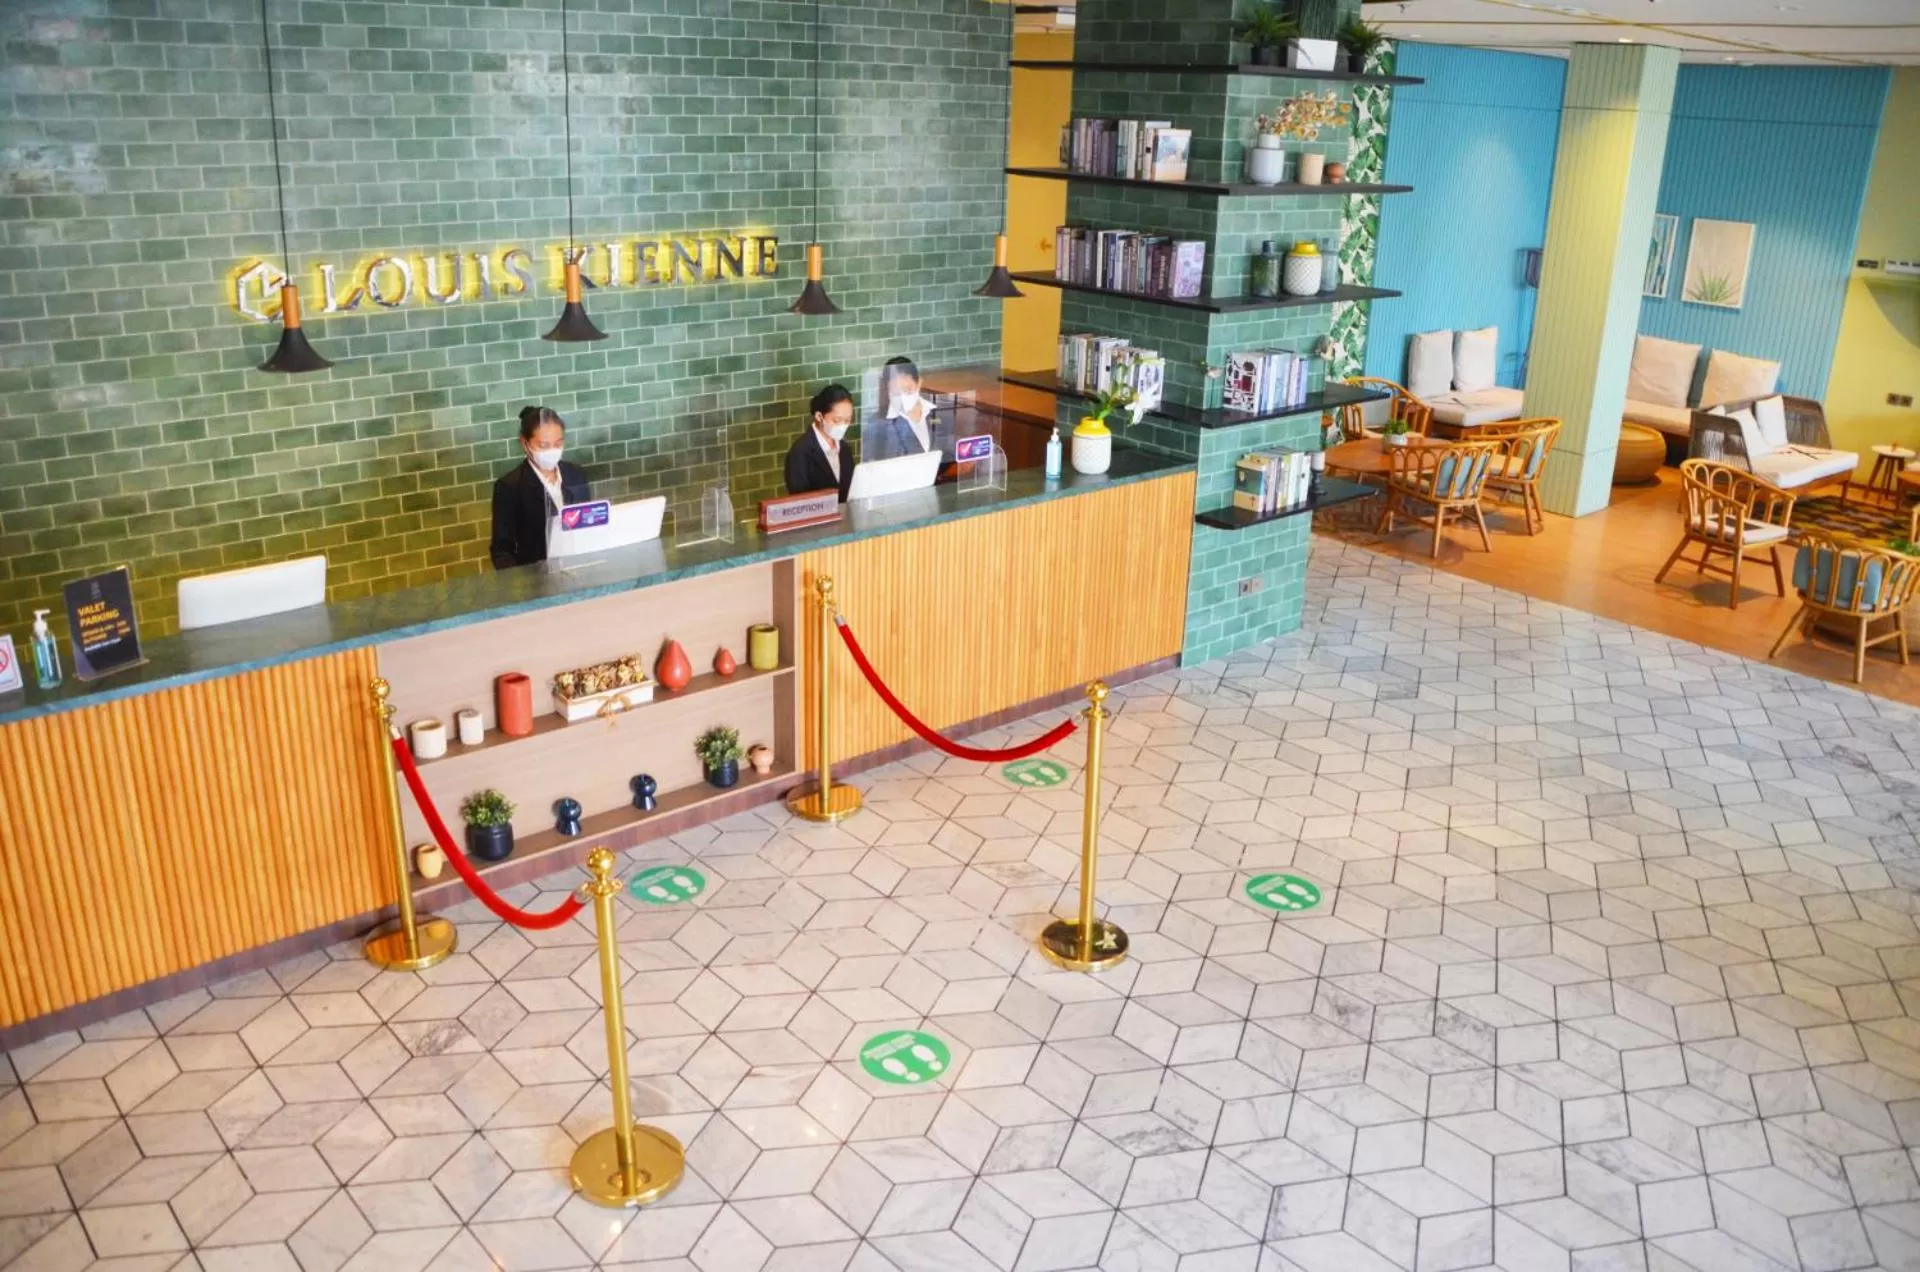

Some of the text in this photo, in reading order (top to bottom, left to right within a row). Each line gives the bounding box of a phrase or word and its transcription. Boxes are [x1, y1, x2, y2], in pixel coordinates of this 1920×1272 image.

[319, 235, 779, 313] LOUIS KIENNE
[782, 502, 824, 516] RECEPTION
[77, 601, 105, 617] VALET
[80, 609, 120, 627] PARKING
